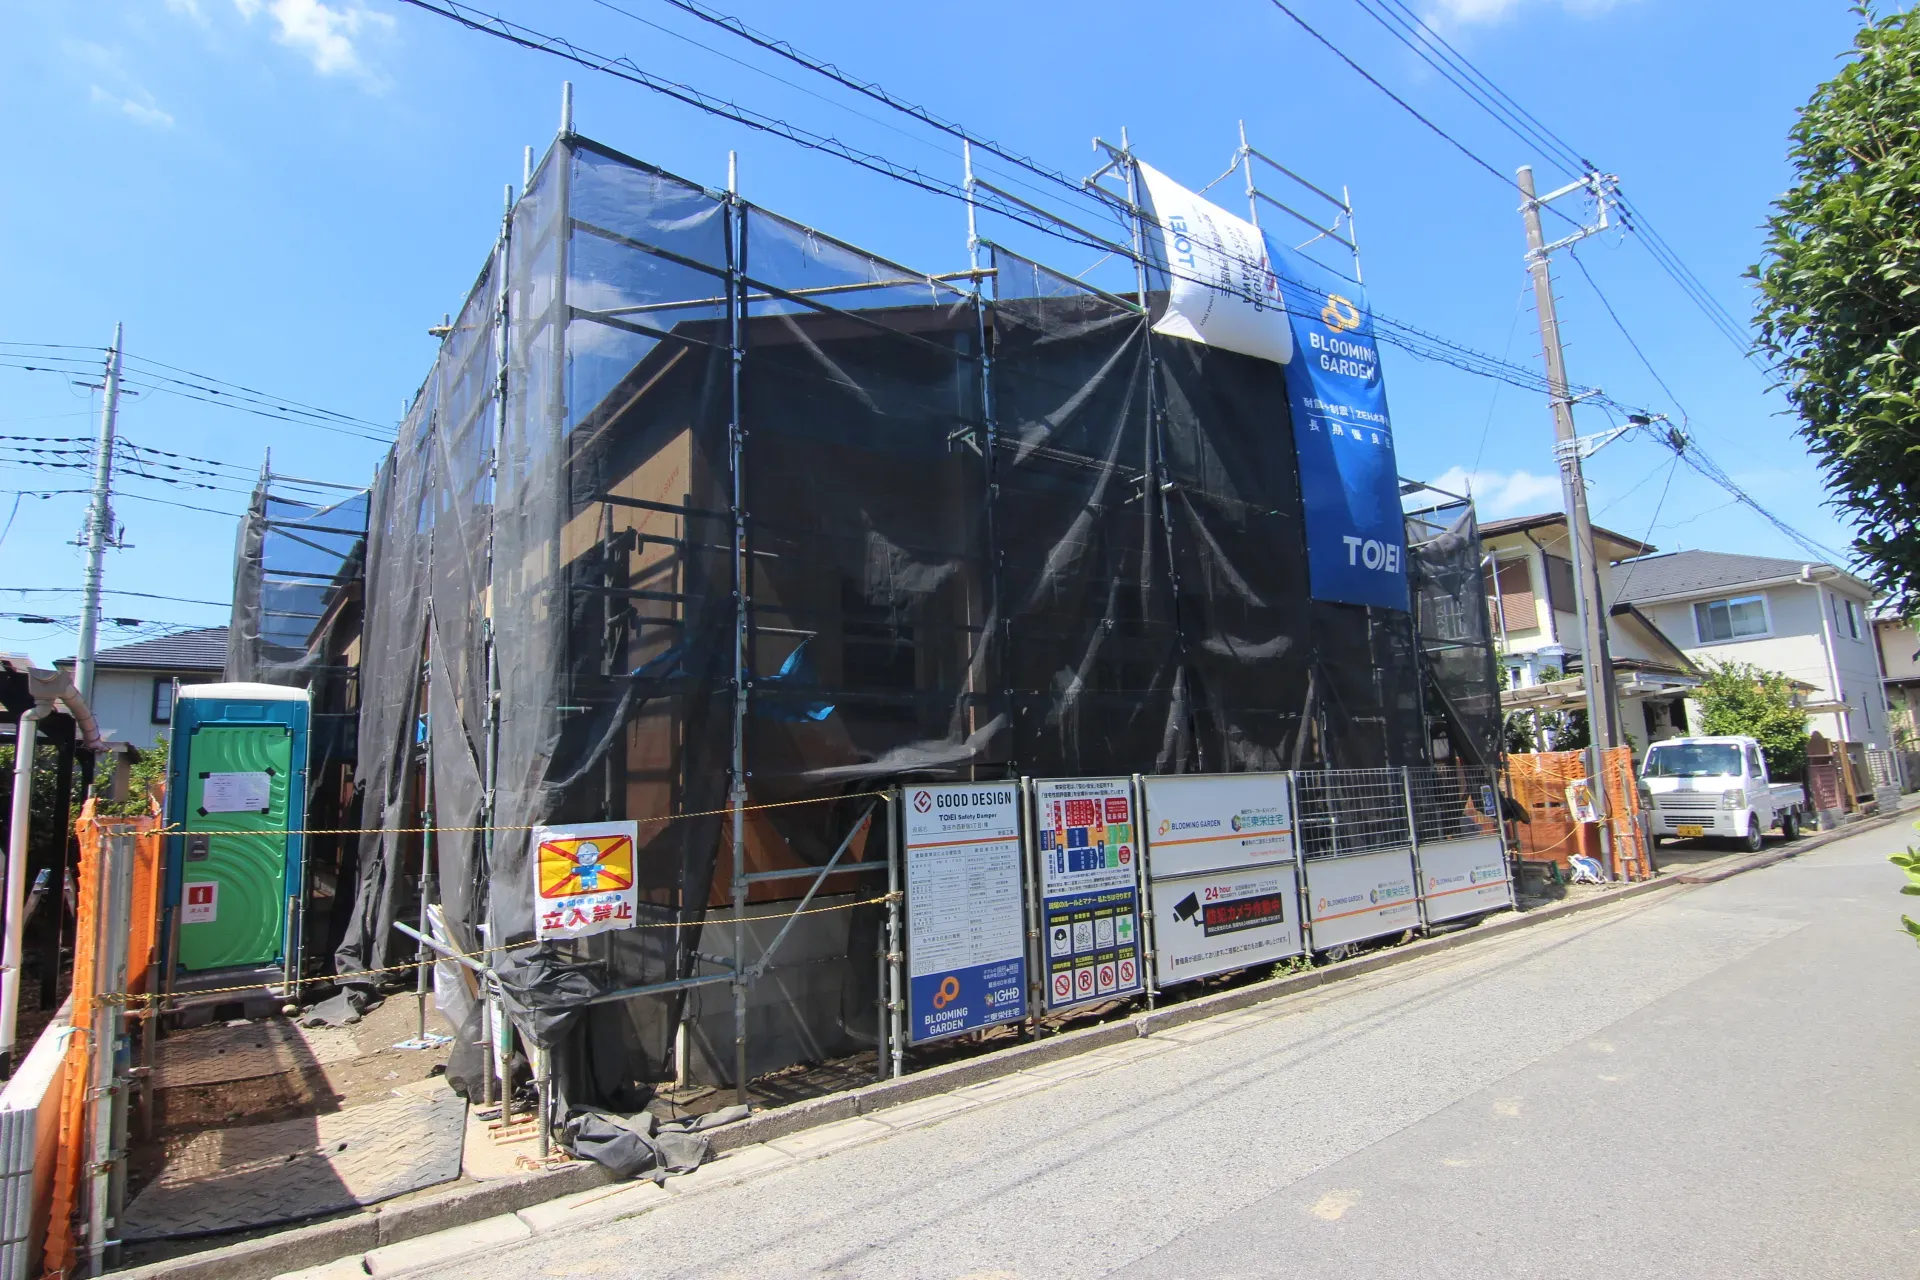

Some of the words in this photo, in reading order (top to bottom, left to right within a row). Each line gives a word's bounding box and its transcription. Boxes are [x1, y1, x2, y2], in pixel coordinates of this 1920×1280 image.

[1309, 332, 1378, 365] BLOOMING
[1320, 355, 1375, 381] GARDEN
[1343, 535, 1400, 574] TOEI
[937, 793, 968, 808] GOOD
[972, 791, 1011, 806] DESIGN
[1171, 820, 1199, 831] BLOOMING
[1200, 819, 1221, 828] GARDEN
[1204, 886, 1218, 901] 24
[1219, 885, 1232, 893] hour
[1327, 898, 1347, 907] BLOOMING
[1348, 894, 1364, 903] GARDEN
[542, 901, 632, 930] 立入禁止
[1206, 898, 1281, 925] 防犯カメラ作動中
[924, 1007, 969, 1025] BLOOMING
[929, 1019, 964, 1035] GARDEN
